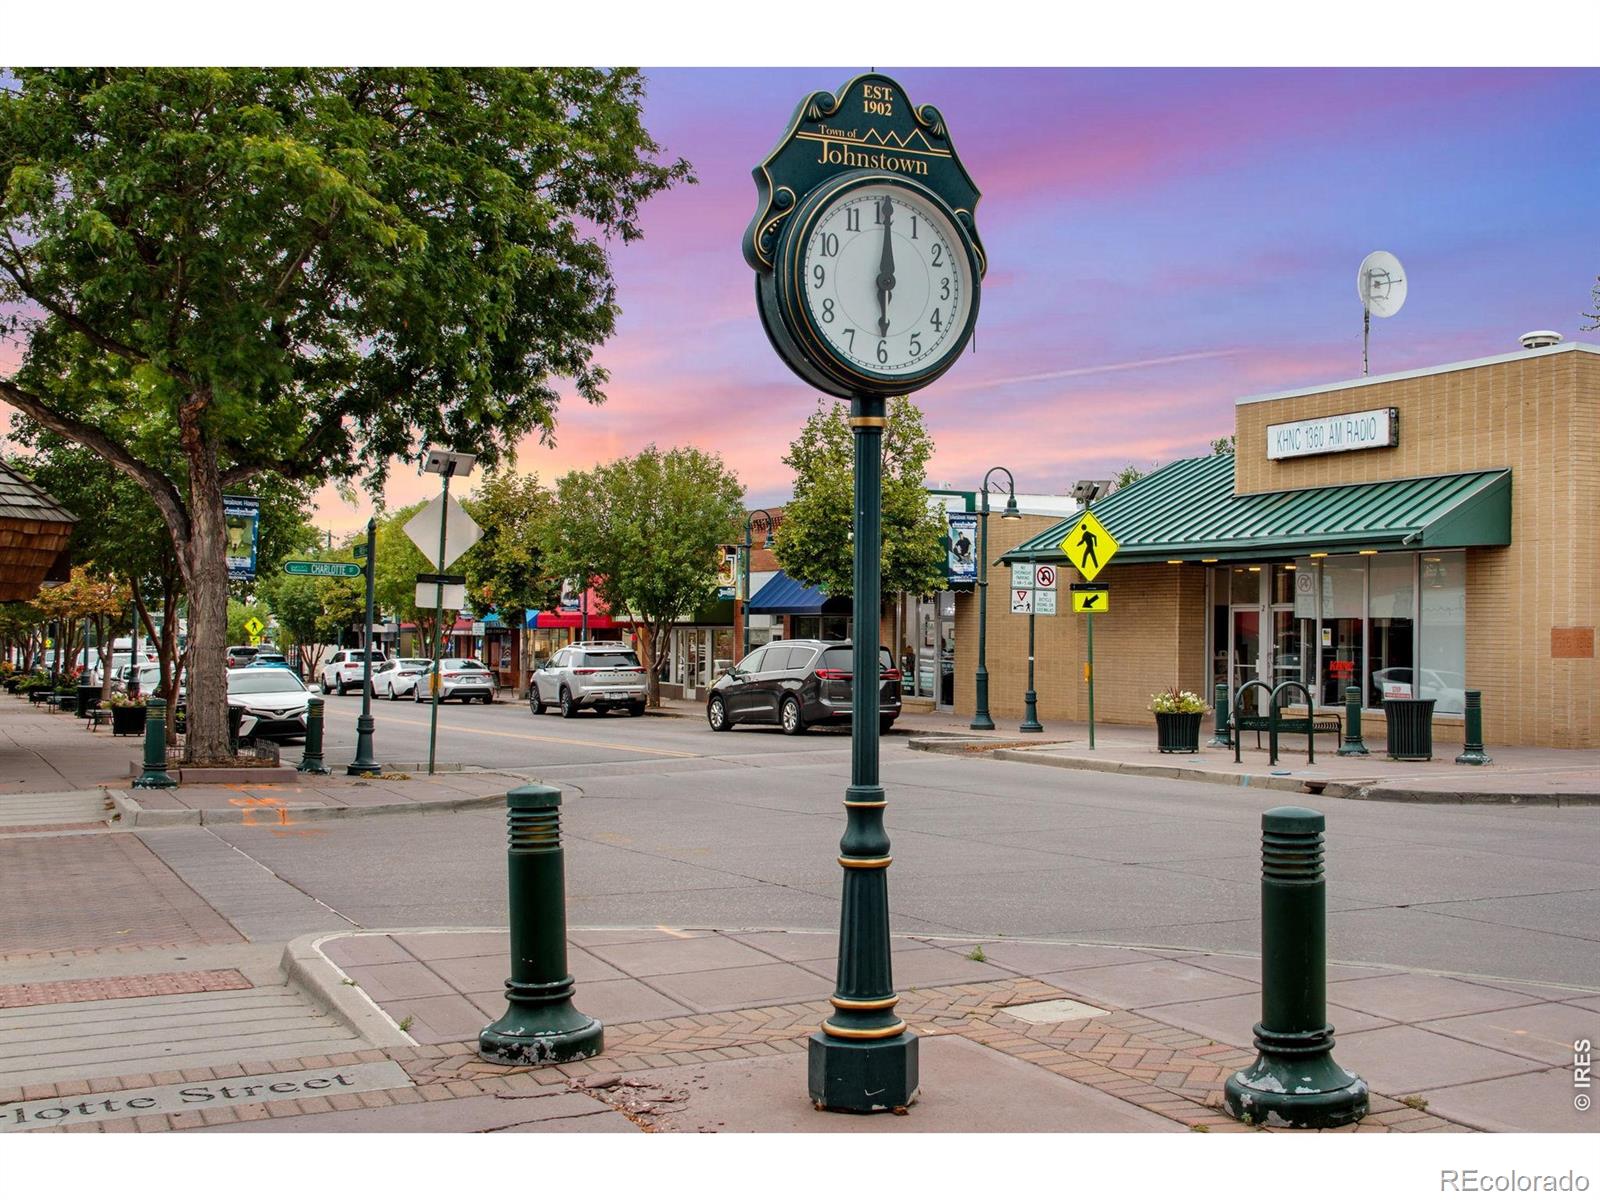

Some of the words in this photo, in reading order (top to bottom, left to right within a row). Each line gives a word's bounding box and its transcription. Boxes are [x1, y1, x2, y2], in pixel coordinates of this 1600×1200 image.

[863, 84, 893, 101] EST.
[863, 100, 892, 116] 1902
[818, 124, 845, 137] Town
[847, 128, 858, 139] of
[817, 139, 929, 175] Johnstown
[845, 208, 861, 232] 11
[910, 216, 918, 239] 1
[820, 232, 839, 257] 10
[931, 243, 943, 267] 2
[813, 265, 825, 289] 9
[940, 277, 950, 300] 3
[821, 298, 834, 323] 8
[930, 307, 942, 332] 4
[842, 329, 855, 354] 7
[876, 340, 888, 364] 6
[909, 332, 921, 356] 5
[1276, 428, 1301, 452] KHNC
[1305, 426, 1324, 449] 1360
[1329, 422, 1342, 445] AM
[1347, 417, 1377, 443] RADIO
[311, 564, 347, 575] CHARLOTTE
[0, 1097, 156, 1124] lotte
[179, 1073, 354, 1104] Street
